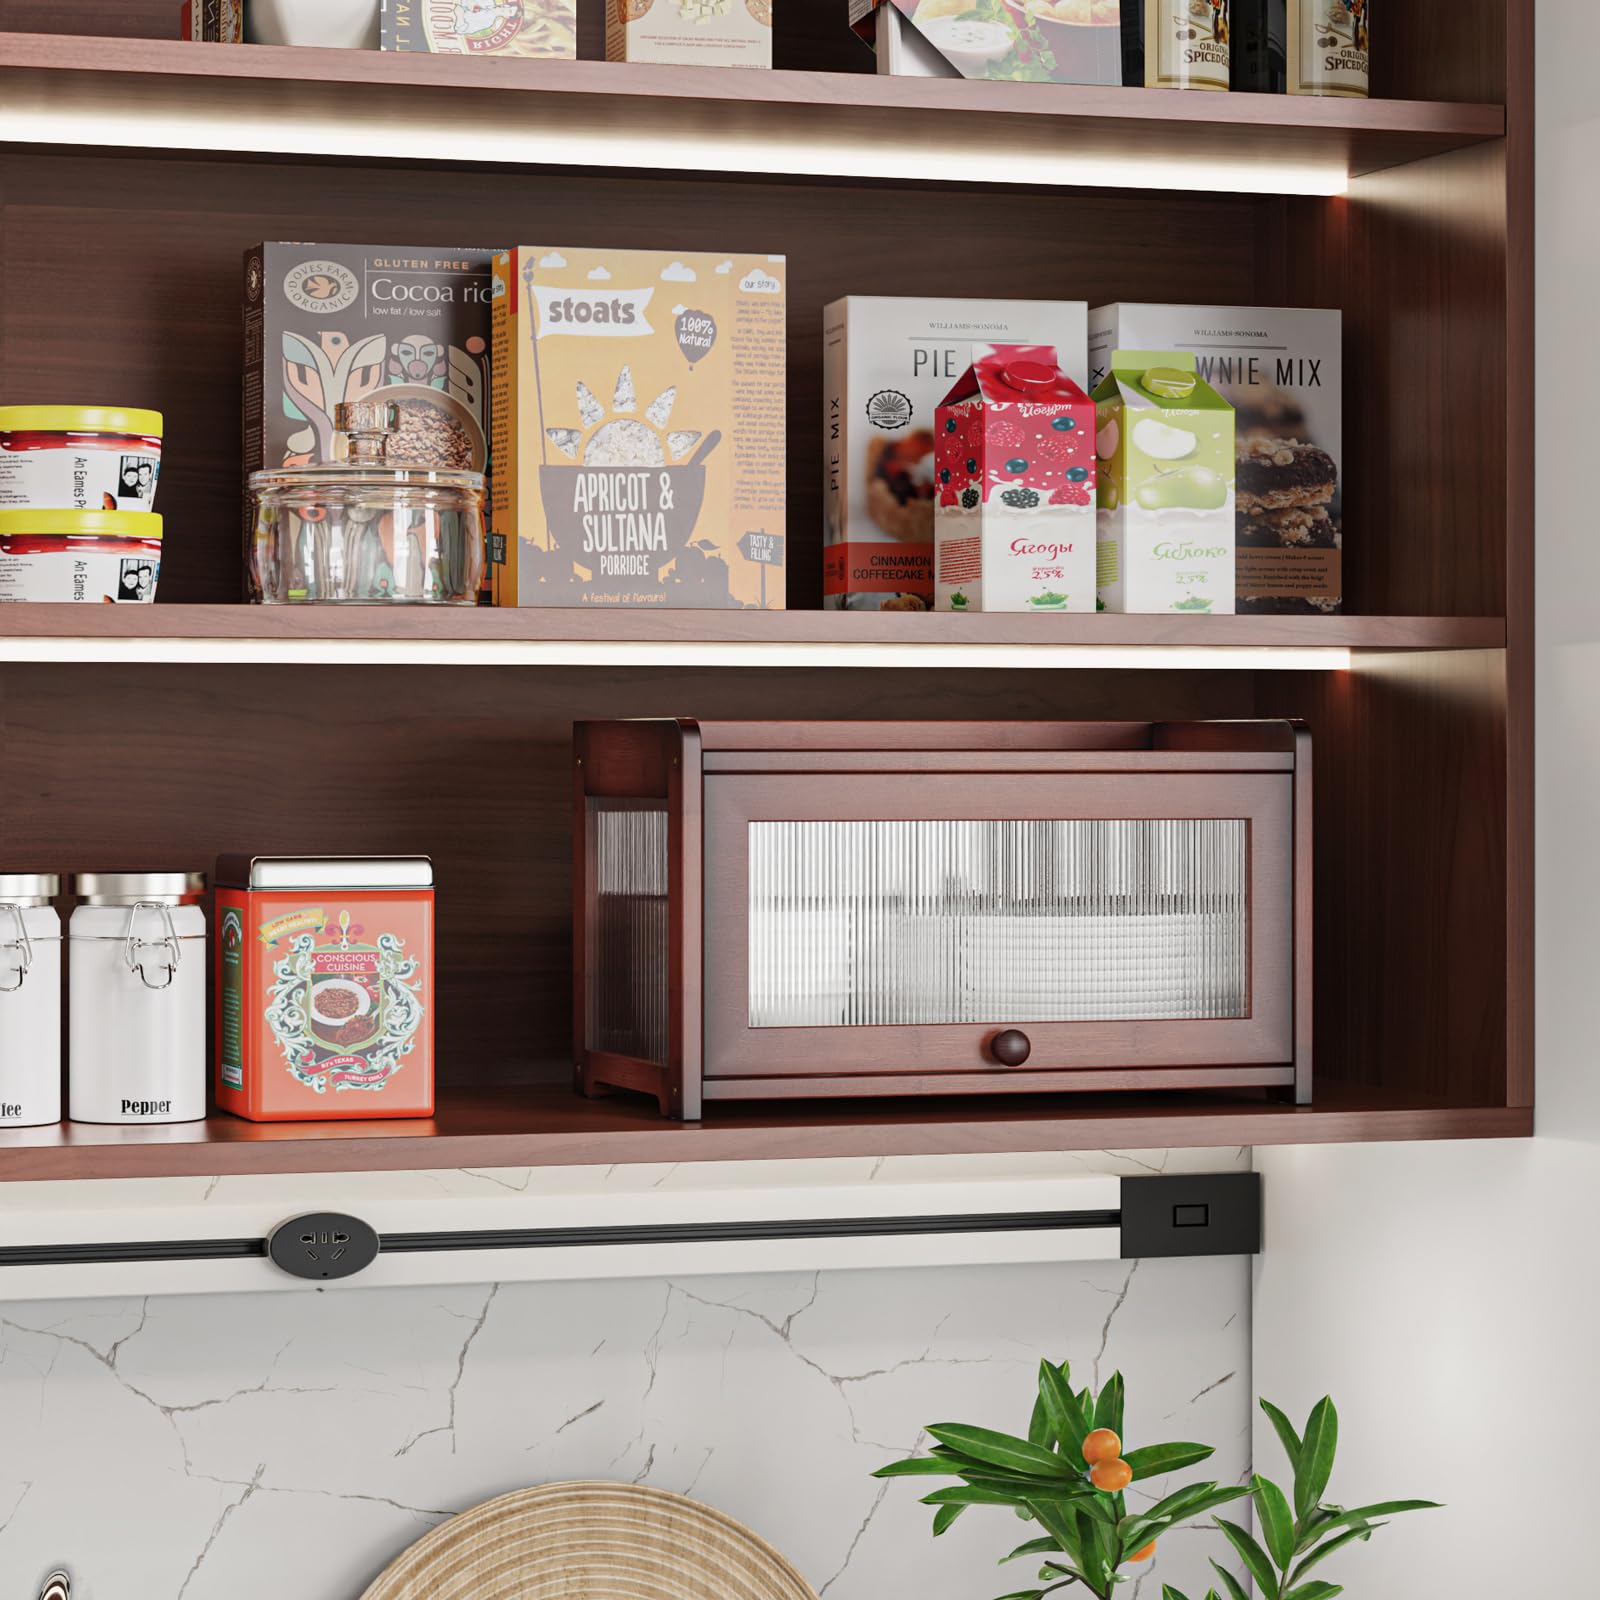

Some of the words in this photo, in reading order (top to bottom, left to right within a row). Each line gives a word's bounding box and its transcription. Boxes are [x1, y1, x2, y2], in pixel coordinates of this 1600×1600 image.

[1183, 49, 1221, 64] SPICED
[1324, 56, 1361, 71] SPICED
[374, 259, 429, 270] GLUTEN
[434, 261, 470, 270] FREE
[288, 264, 323, 290] DOVES
[326, 264, 353, 290] FARM
[372, 278, 454, 302] Cocoa
[757, 280, 776, 291] story
[293, 293, 350, 311] ORGANIC
[372, 307, 389, 316] low
[390, 307, 401, 316] fat
[409, 307, 426, 316] low
[426, 308, 442, 317] salt
[549, 297, 636, 324] stoats
[680, 317, 714, 335] 100%
[928, 321, 1009, 331] WILLIAMS-SONOMA
[1193, 329, 1269, 338] WILLIAMS-SONOMA
[679, 334, 712, 349] Natural
[913, 348, 957, 378] PIE
[1277, 358, 1322, 387] MIX
[830, 398, 840, 440] MIX
[74, 456, 88, 469] An
[830, 454, 840, 490] PIE
[73, 470, 88, 497] Eames
[573, 472, 651, 513] APRICOT
[659, 471, 674, 511] &
[582, 512, 668, 552] SULTANA
[750, 534, 767, 547] TASTY
[768, 536, 774, 548] &
[1009, 538, 1073, 560] Ягоды
[751, 548, 772, 561] FILLING
[1151, 542, 1227, 561] Яблоко
[74, 560, 88, 572] An
[600, 554, 650, 576] PORRIDGE
[870, 556, 932, 567] CINNAMON
[853, 569, 924, 580] COFFEECAKE
[73, 573, 88, 601] Eames
[582, 594, 589, 602] A
[590, 593, 620, 603] festival
[622, 593, 631, 603] of
[316, 954, 376, 963] CONSCIOUS
[326, 963, 366, 971] CUISINE
[121, 1099, 172, 1116] Pepper
